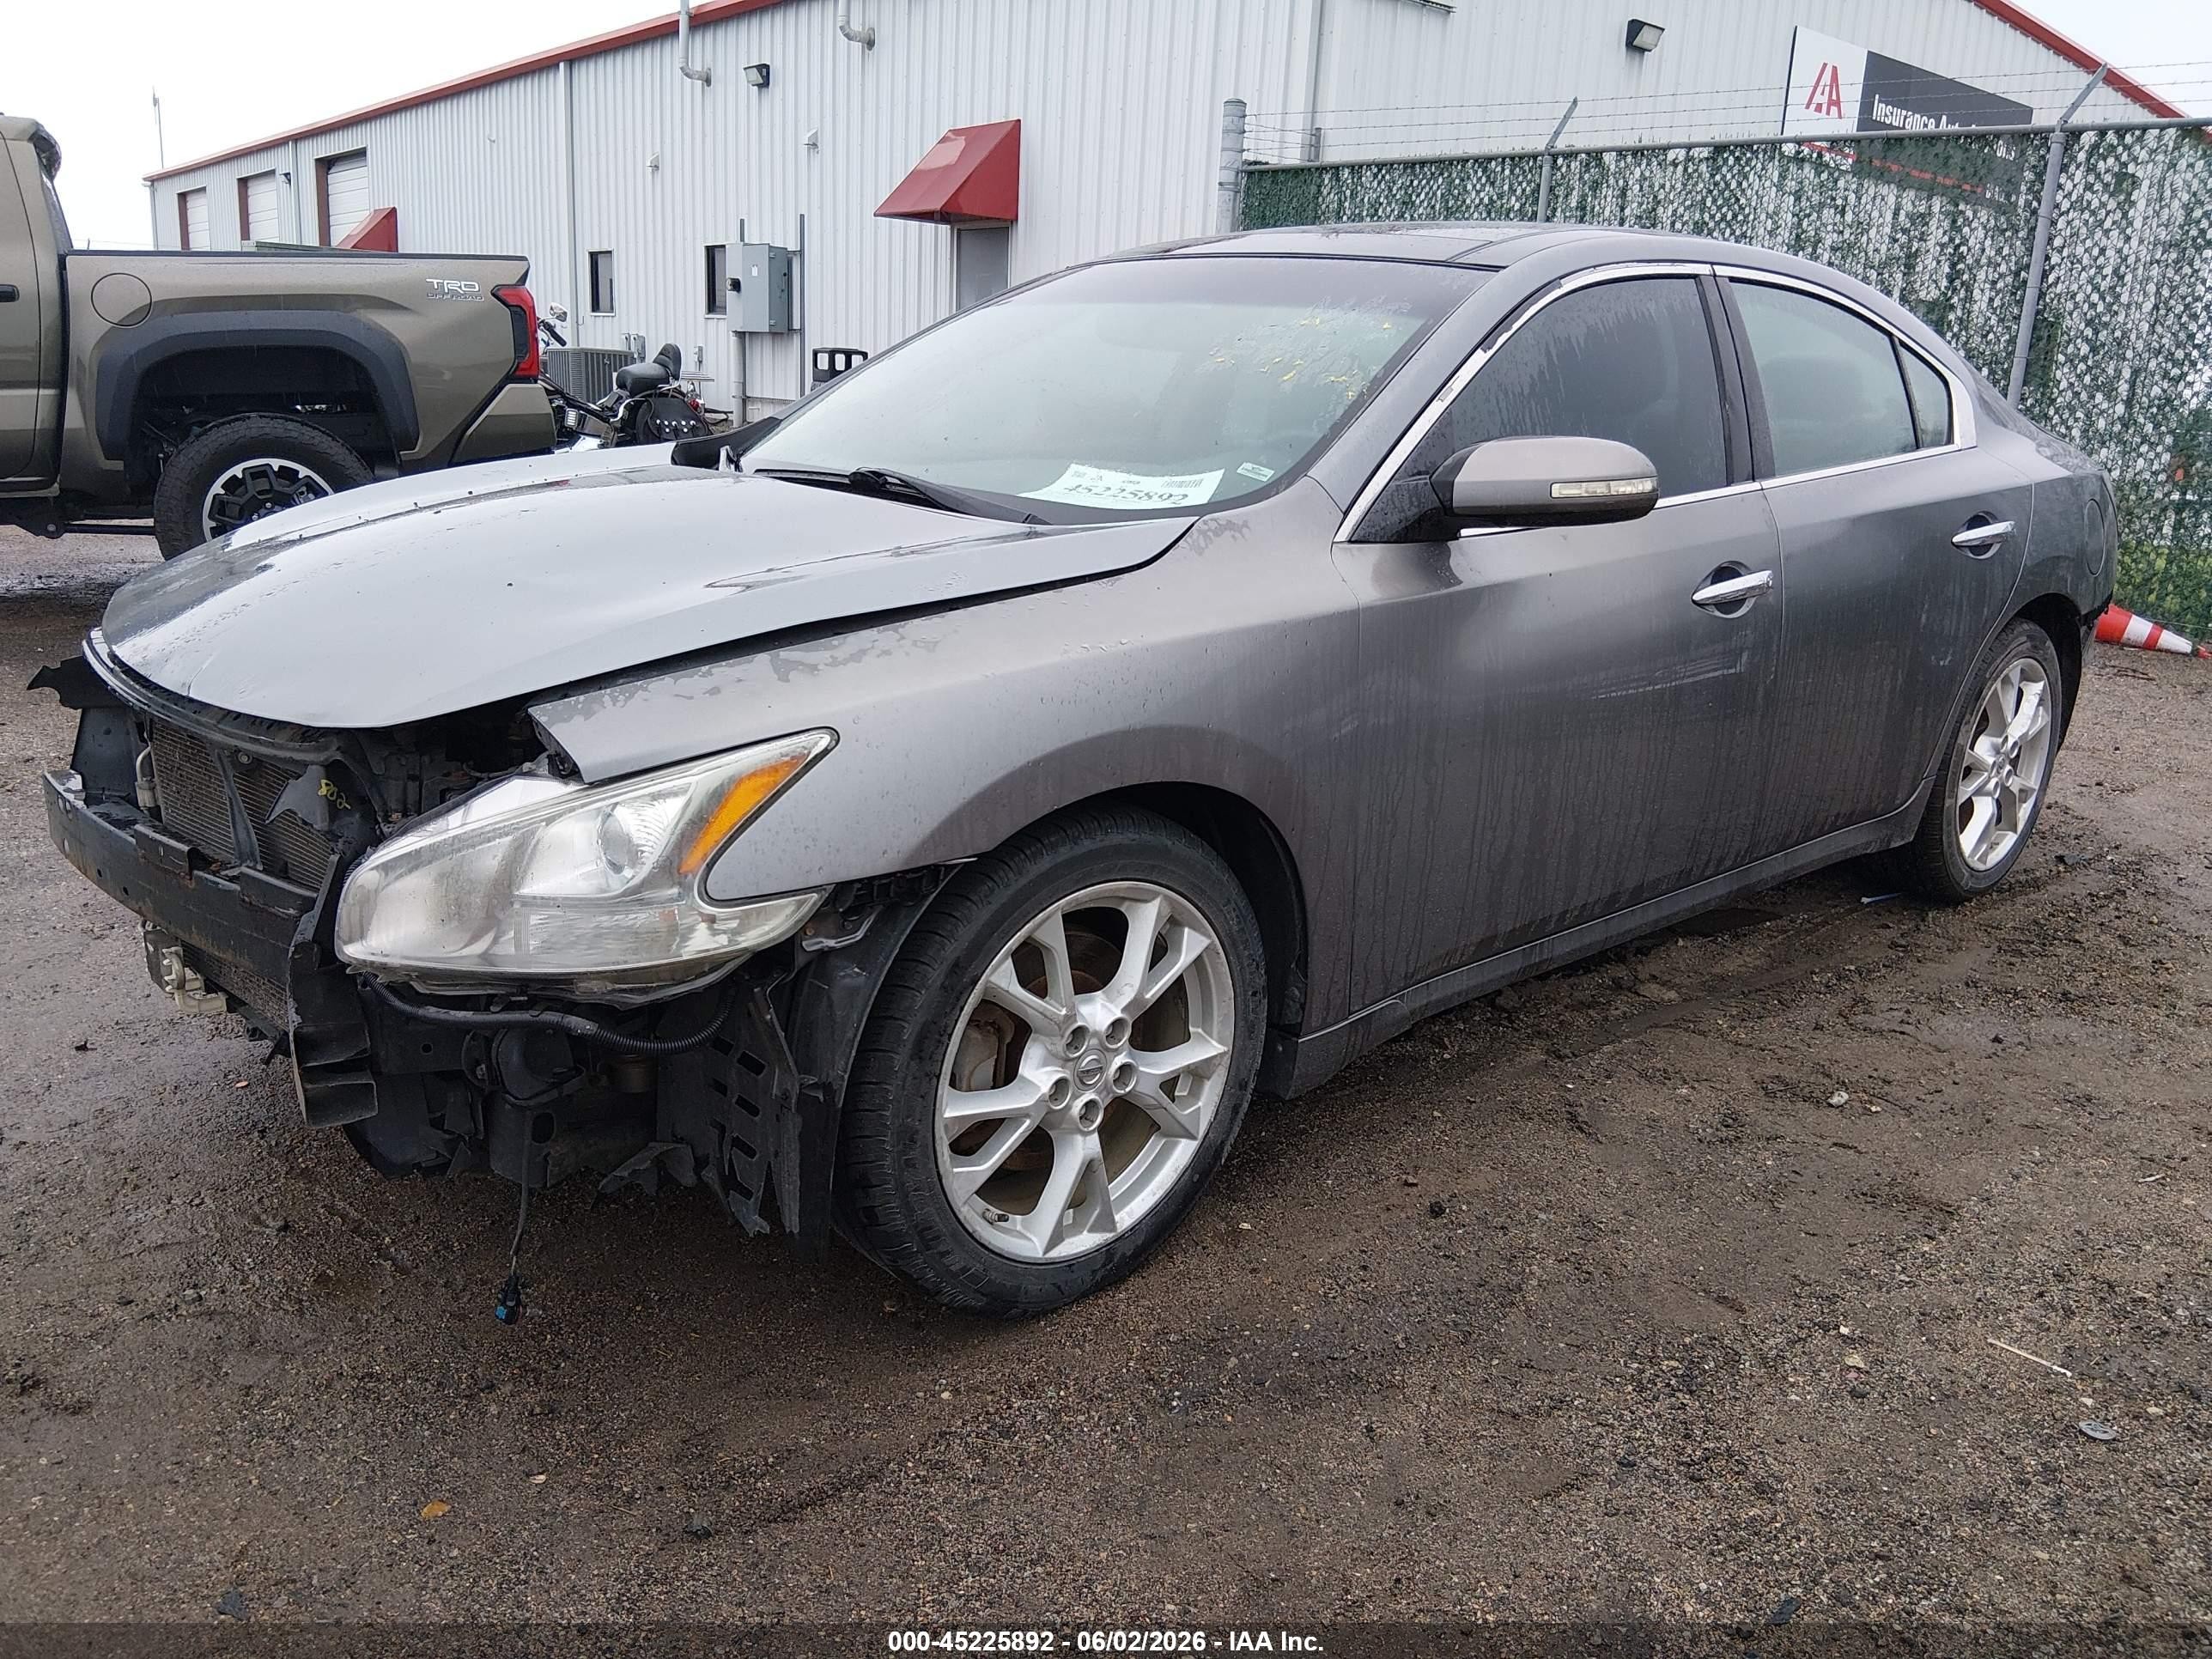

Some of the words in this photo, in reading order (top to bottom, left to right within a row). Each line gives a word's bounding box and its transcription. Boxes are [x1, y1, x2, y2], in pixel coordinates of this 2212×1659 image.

[1871, 94, 1936, 131] Insurance
[425, 279, 480, 294] TRD
[1064, 483, 1189, 505] 45225892
